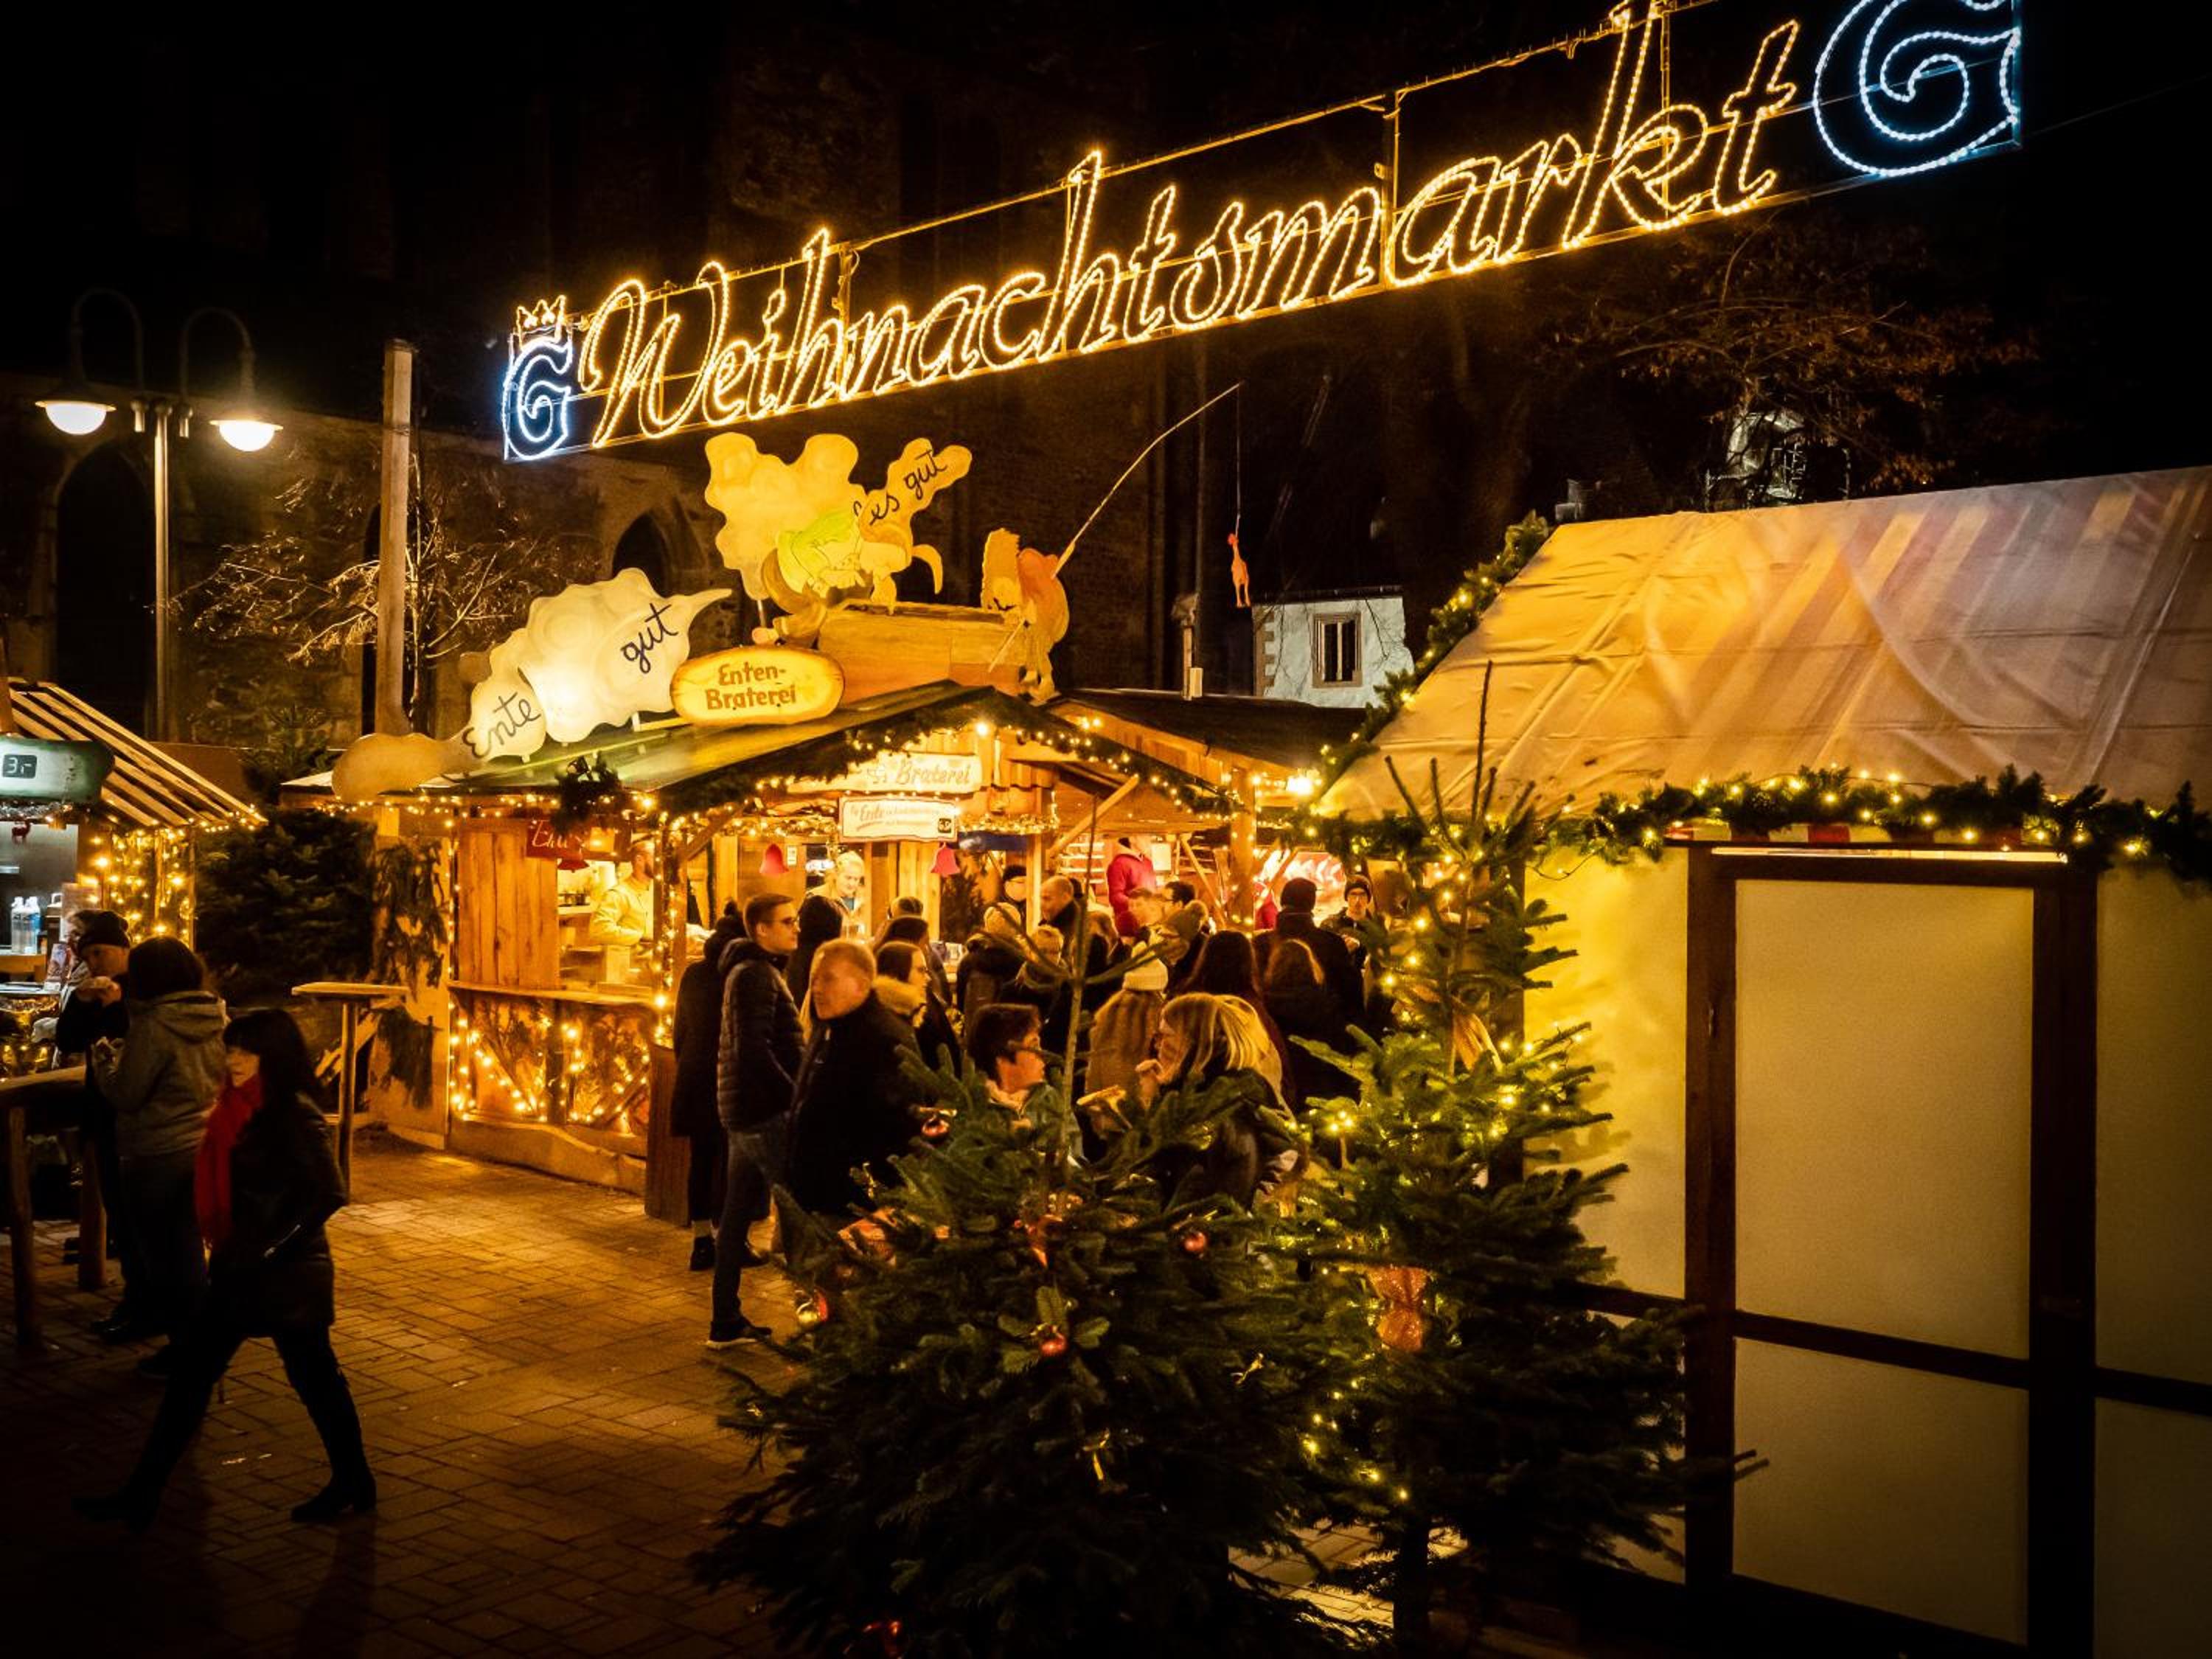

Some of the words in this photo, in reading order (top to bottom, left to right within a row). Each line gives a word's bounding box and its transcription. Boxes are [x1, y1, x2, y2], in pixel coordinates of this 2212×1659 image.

[577, 0, 1799, 449] Weihnachtsmarkt
[903, 449, 948, 500] gut
[463, 690, 542, 759] Ente
[620, 602, 679, 674] gut
[705, 683, 796, 710] Braterei
[717, 661, 786, 686] Enten-
